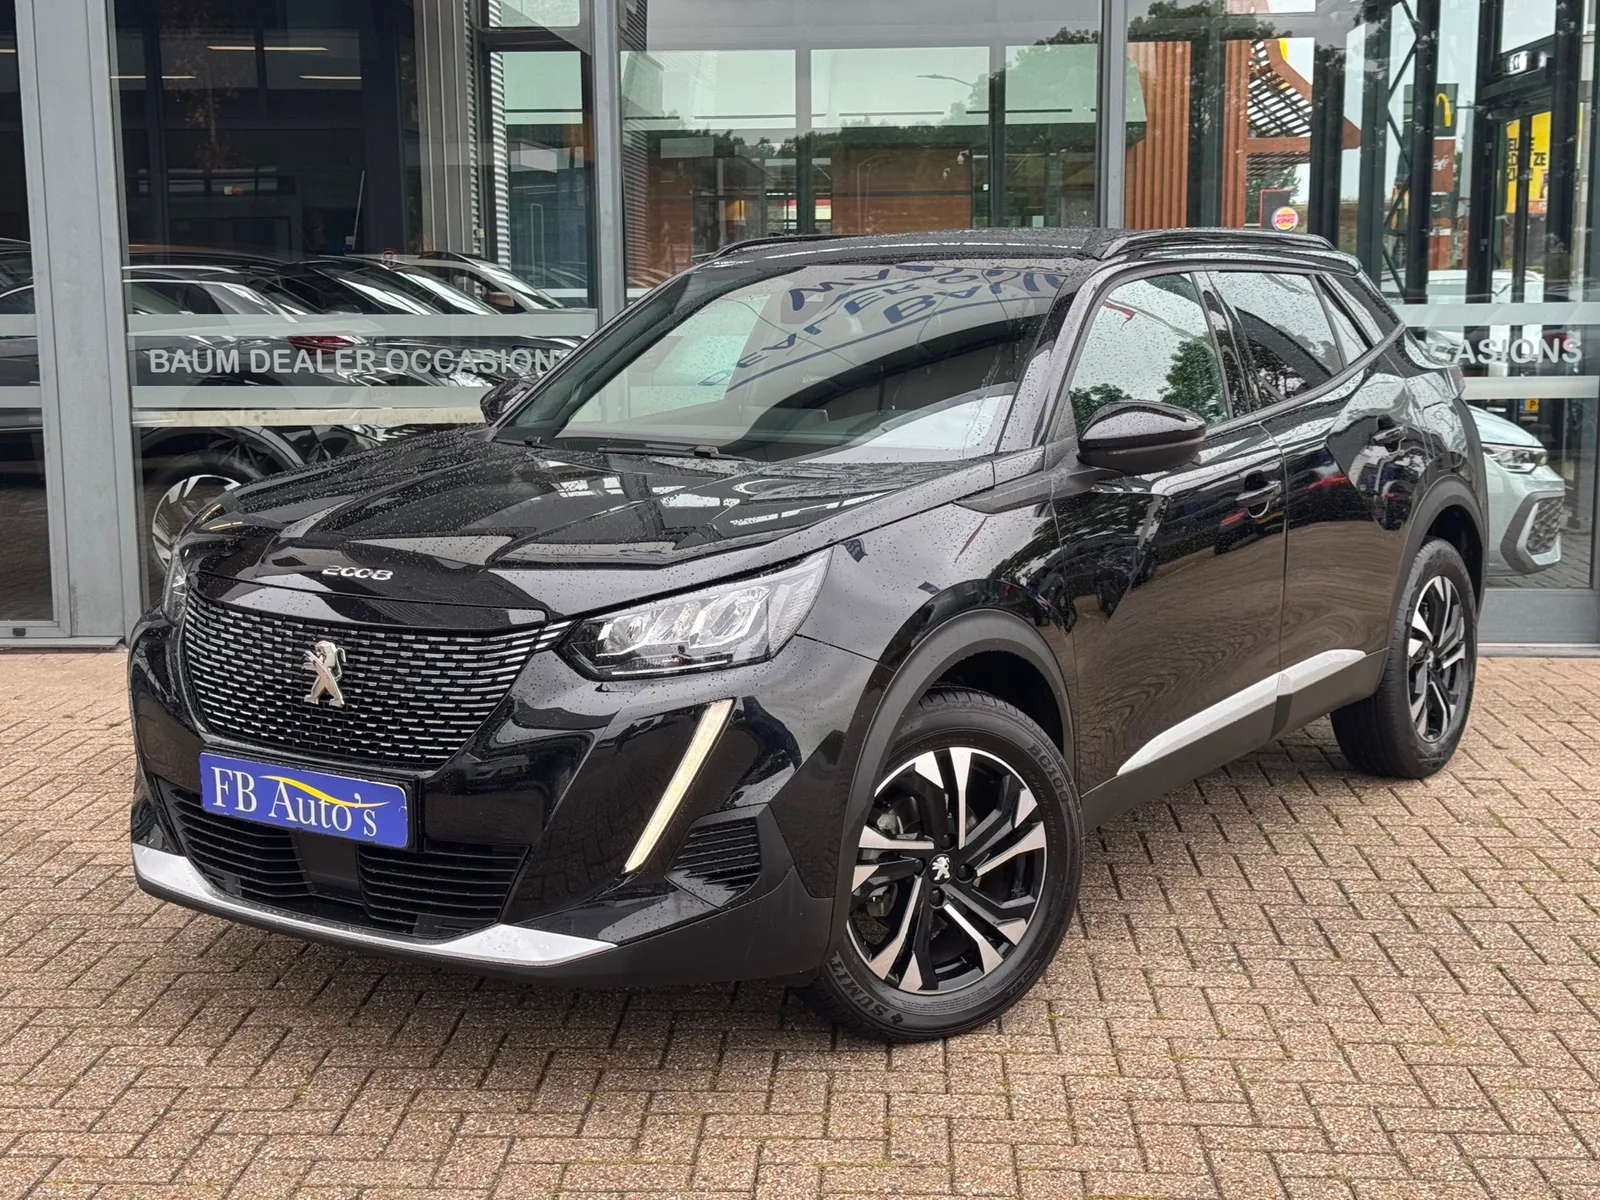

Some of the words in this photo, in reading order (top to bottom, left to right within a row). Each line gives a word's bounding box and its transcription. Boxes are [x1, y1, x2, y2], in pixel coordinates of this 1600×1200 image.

[150, 349, 240, 374] BAUM
[250, 349, 377, 374] DEALER
[386, 349, 573, 375] OCCASION
[1417, 338, 1583, 364] CASIONS
[321, 565, 394, 581] 2008
[210, 766, 258, 814] FB
[268, 779, 378, 838] Auto's
